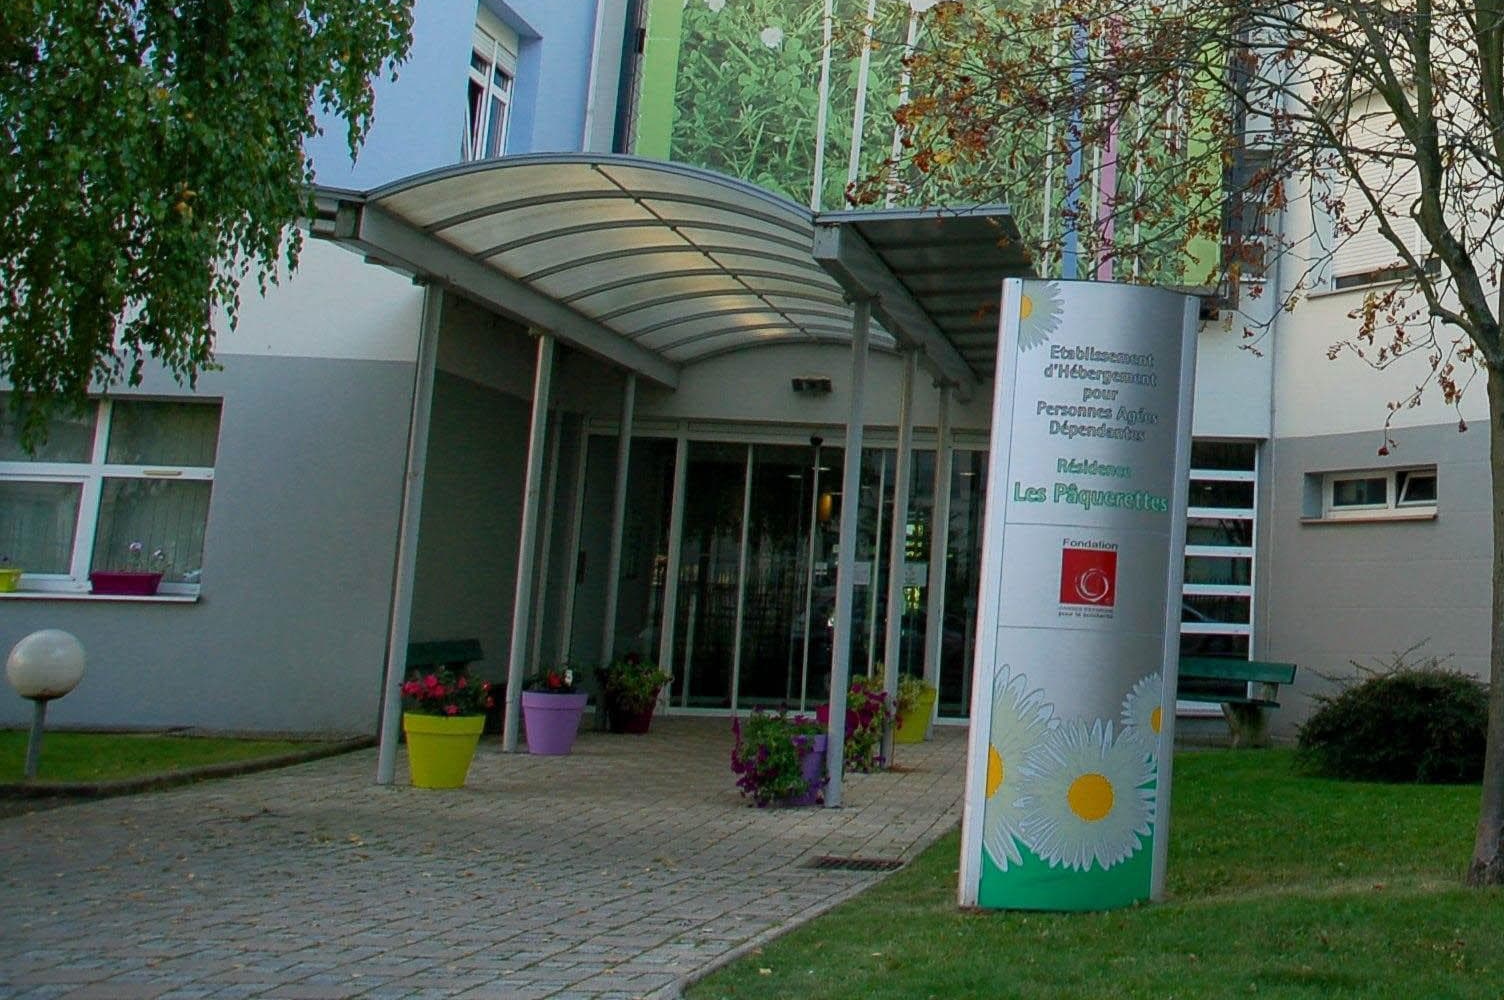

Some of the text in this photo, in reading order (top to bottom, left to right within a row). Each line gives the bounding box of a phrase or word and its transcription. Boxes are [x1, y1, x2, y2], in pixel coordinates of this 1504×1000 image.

[1050, 344, 1155, 367] Etablissement
[1044, 363, 1158, 387] d'Hébergement
[1082, 387, 1119, 402] pour
[1036, 400, 1113, 419] Personnes
[1049, 419, 1146, 441] Dépendantes
[1057, 457, 1134, 479] Résidence
[1013, 481, 1169, 512] Les Pâquerettes
[1062, 537, 1119, 550] Fondation
